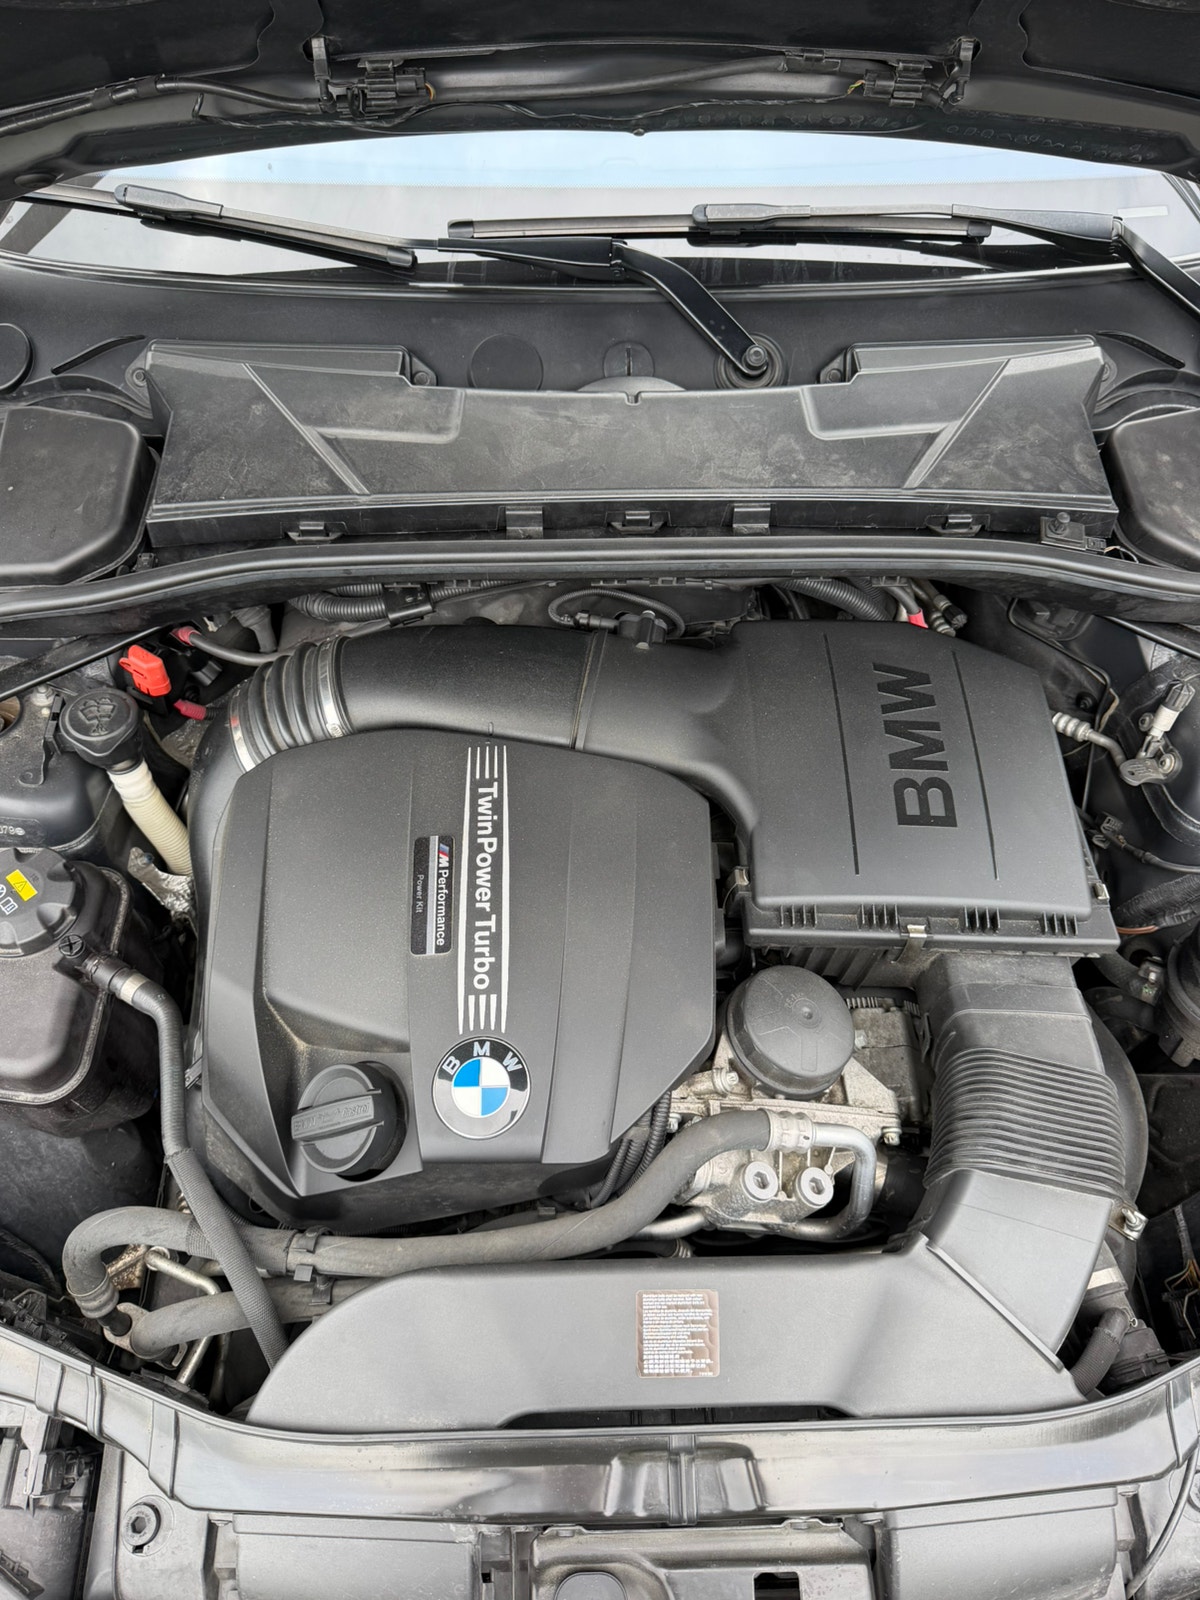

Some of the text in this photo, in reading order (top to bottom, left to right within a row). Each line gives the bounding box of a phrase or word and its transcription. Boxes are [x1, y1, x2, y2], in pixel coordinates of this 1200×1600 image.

[872, 662, 958, 828] BMW
[415, 874, 424, 913] Power Kit
[436, 869, 449, 946] Performance
[473, 781, 498, 990] TwinPower Turbo
[442, 1041, 523, 1076] BMW
